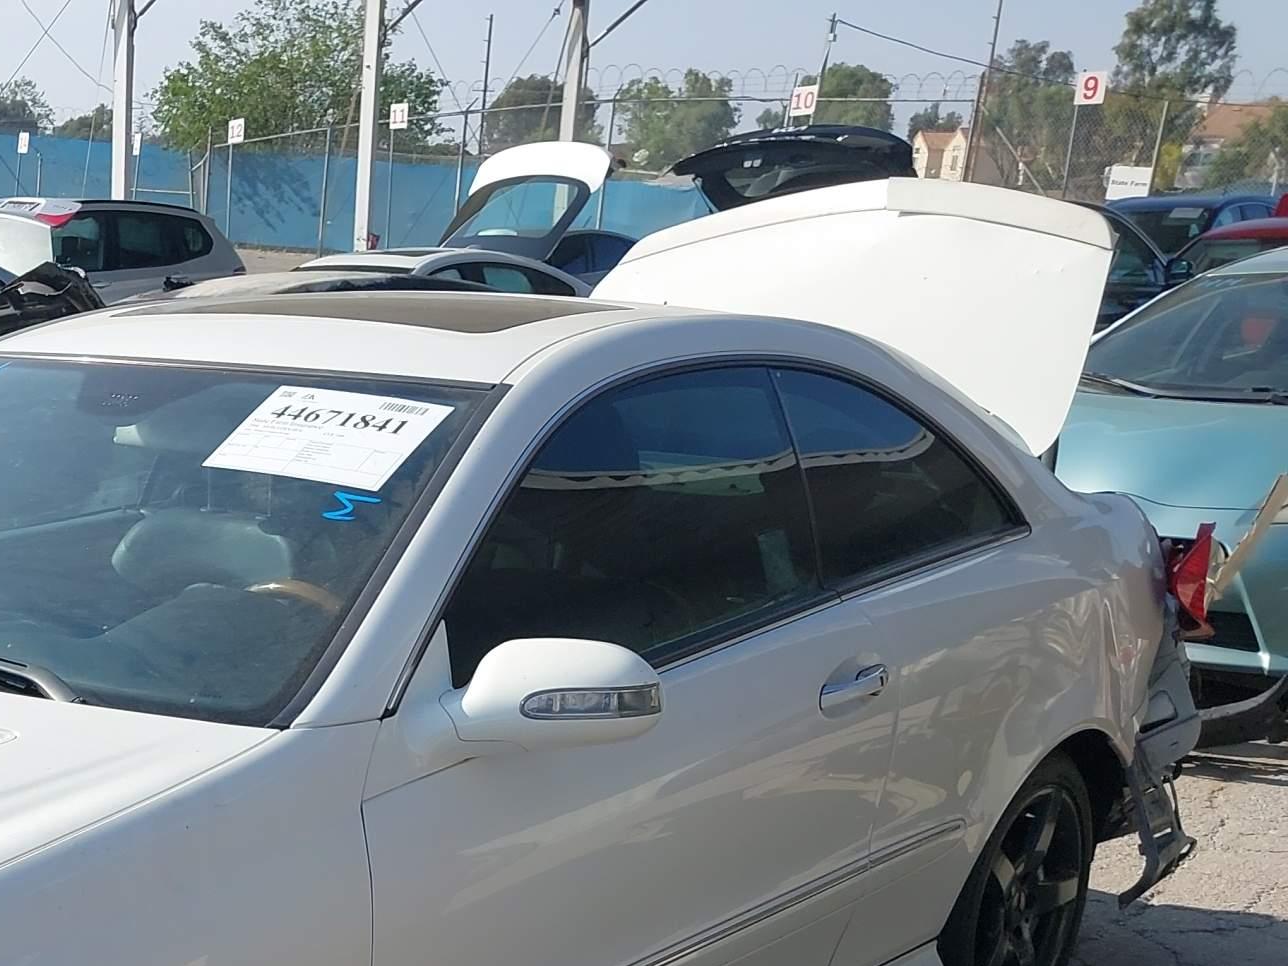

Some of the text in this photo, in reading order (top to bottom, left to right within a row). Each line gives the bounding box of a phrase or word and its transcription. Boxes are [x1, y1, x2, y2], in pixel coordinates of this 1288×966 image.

[1083, 76, 1099, 100] 9
[792, 92, 815, 110] 10
[392, 109, 406, 124] 11
[230, 124, 243, 139] 12
[271, 404, 408, 434] 44671841
